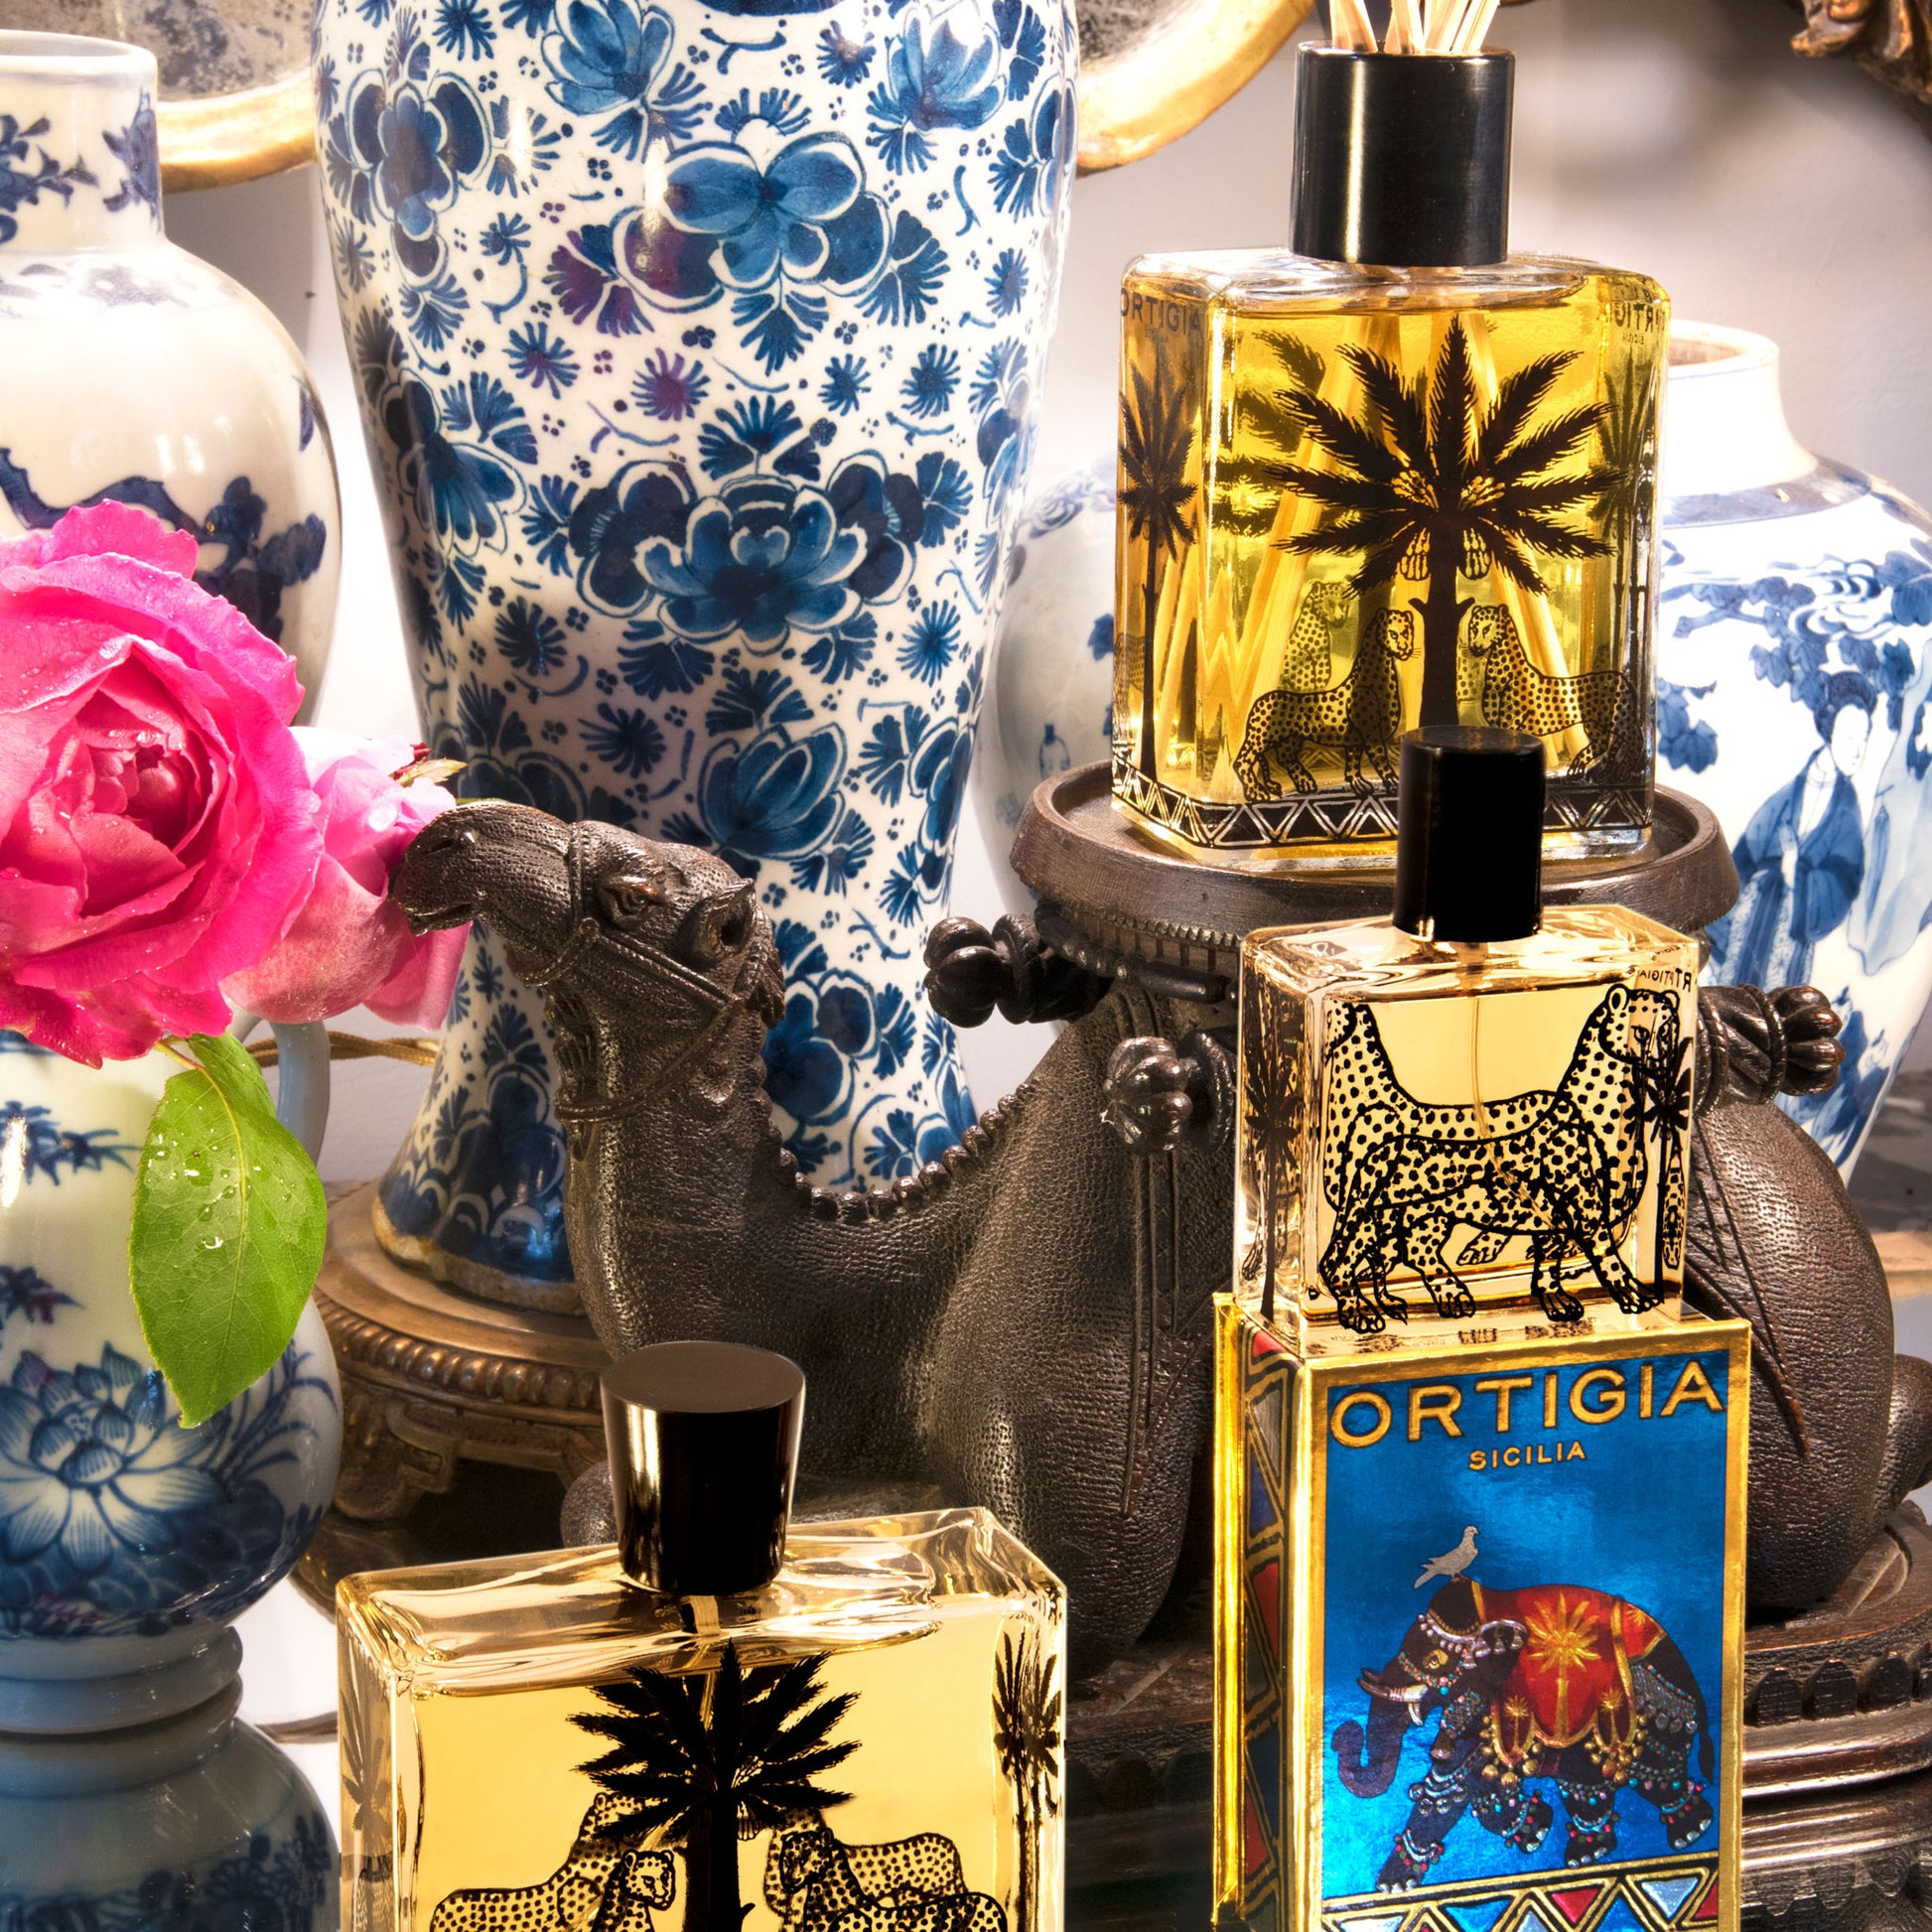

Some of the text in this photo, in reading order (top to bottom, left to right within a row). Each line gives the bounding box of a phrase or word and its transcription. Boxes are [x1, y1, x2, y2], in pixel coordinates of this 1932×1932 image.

[1120, 287, 1205, 340] ORTIGIA
[1330, 1359, 1725, 1449] ORTIGIA
[1468, 1440, 1587, 1470] SICILIA
